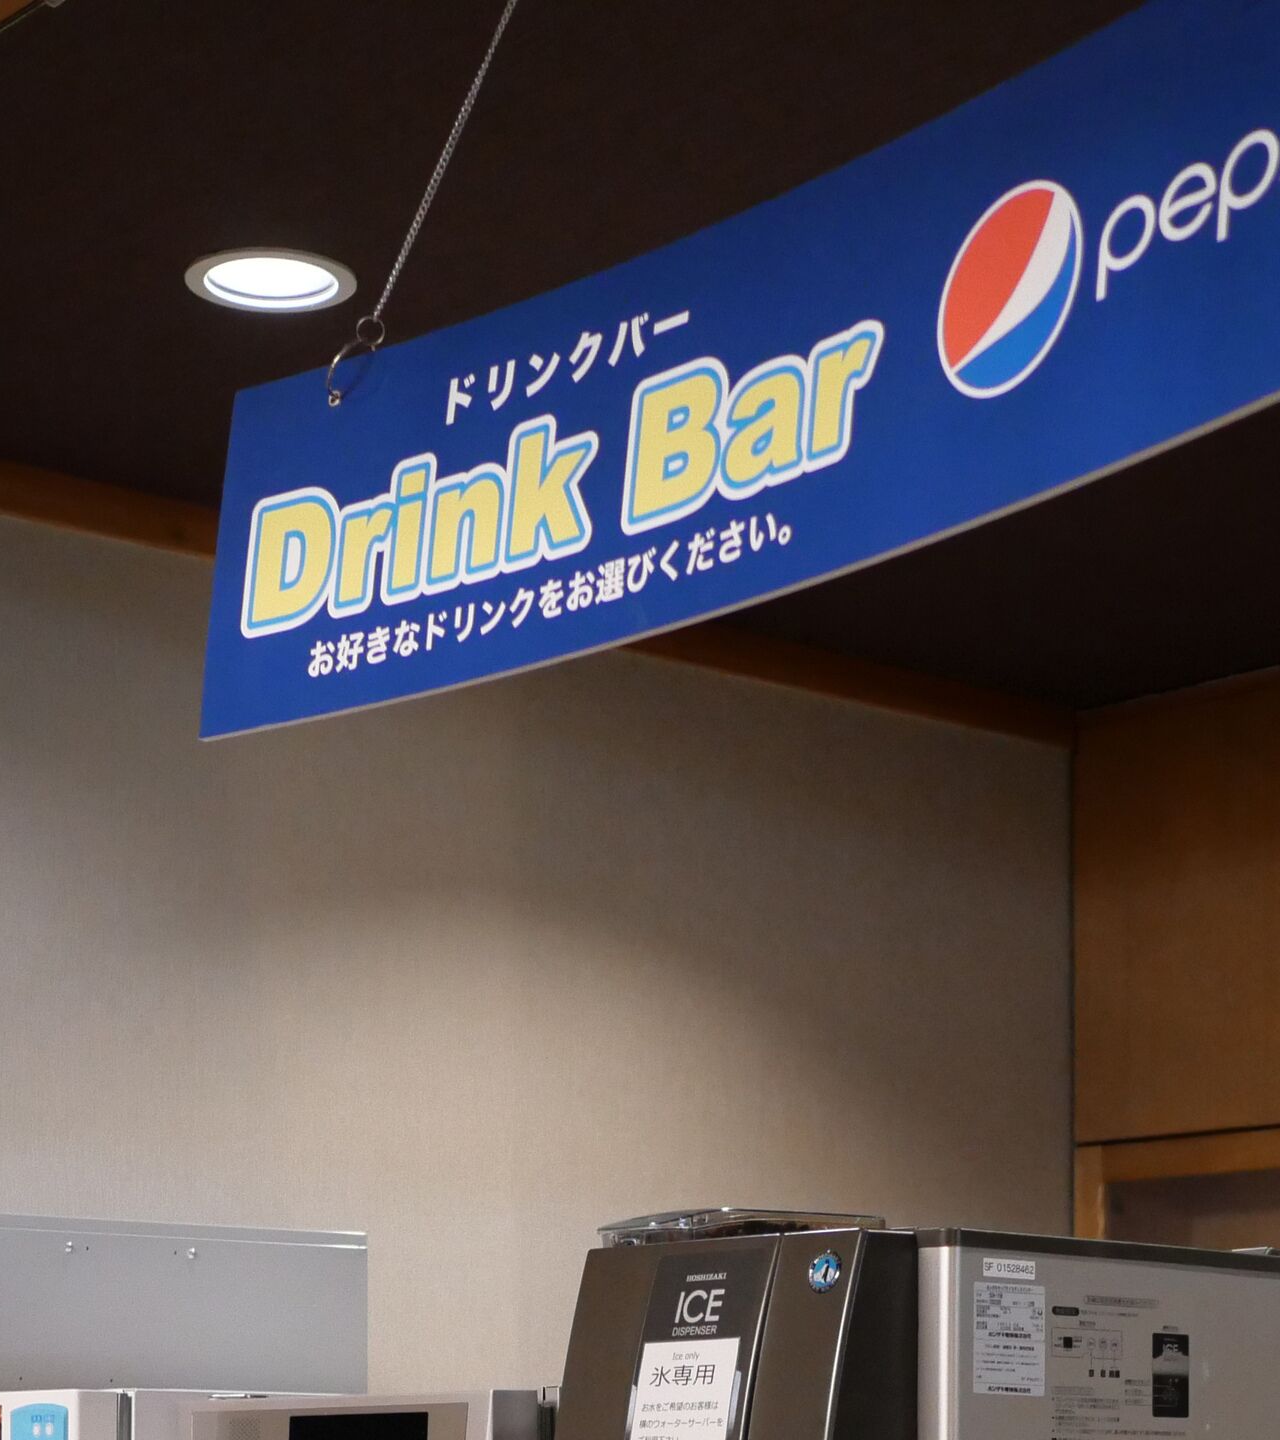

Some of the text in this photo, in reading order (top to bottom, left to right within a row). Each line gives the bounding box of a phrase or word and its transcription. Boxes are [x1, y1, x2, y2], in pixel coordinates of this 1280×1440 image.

[444, 309, 690, 424] ドリンクバー
[241, 319, 884, 640] Drink Bar
[307, 522, 793, 679] お好きなドリンクをお選びください。
[686, 1272, 727, 1282] HOSHIZAKI
[674, 1288, 726, 1324] ICE
[672, 1325, 718, 1337] DISPENSER
[672, 1351, 701, 1361] Ice only
[649, 1364, 716, 1387] 氷専用
[641, 1401, 719, 1413] お水をご希望のお客様は
